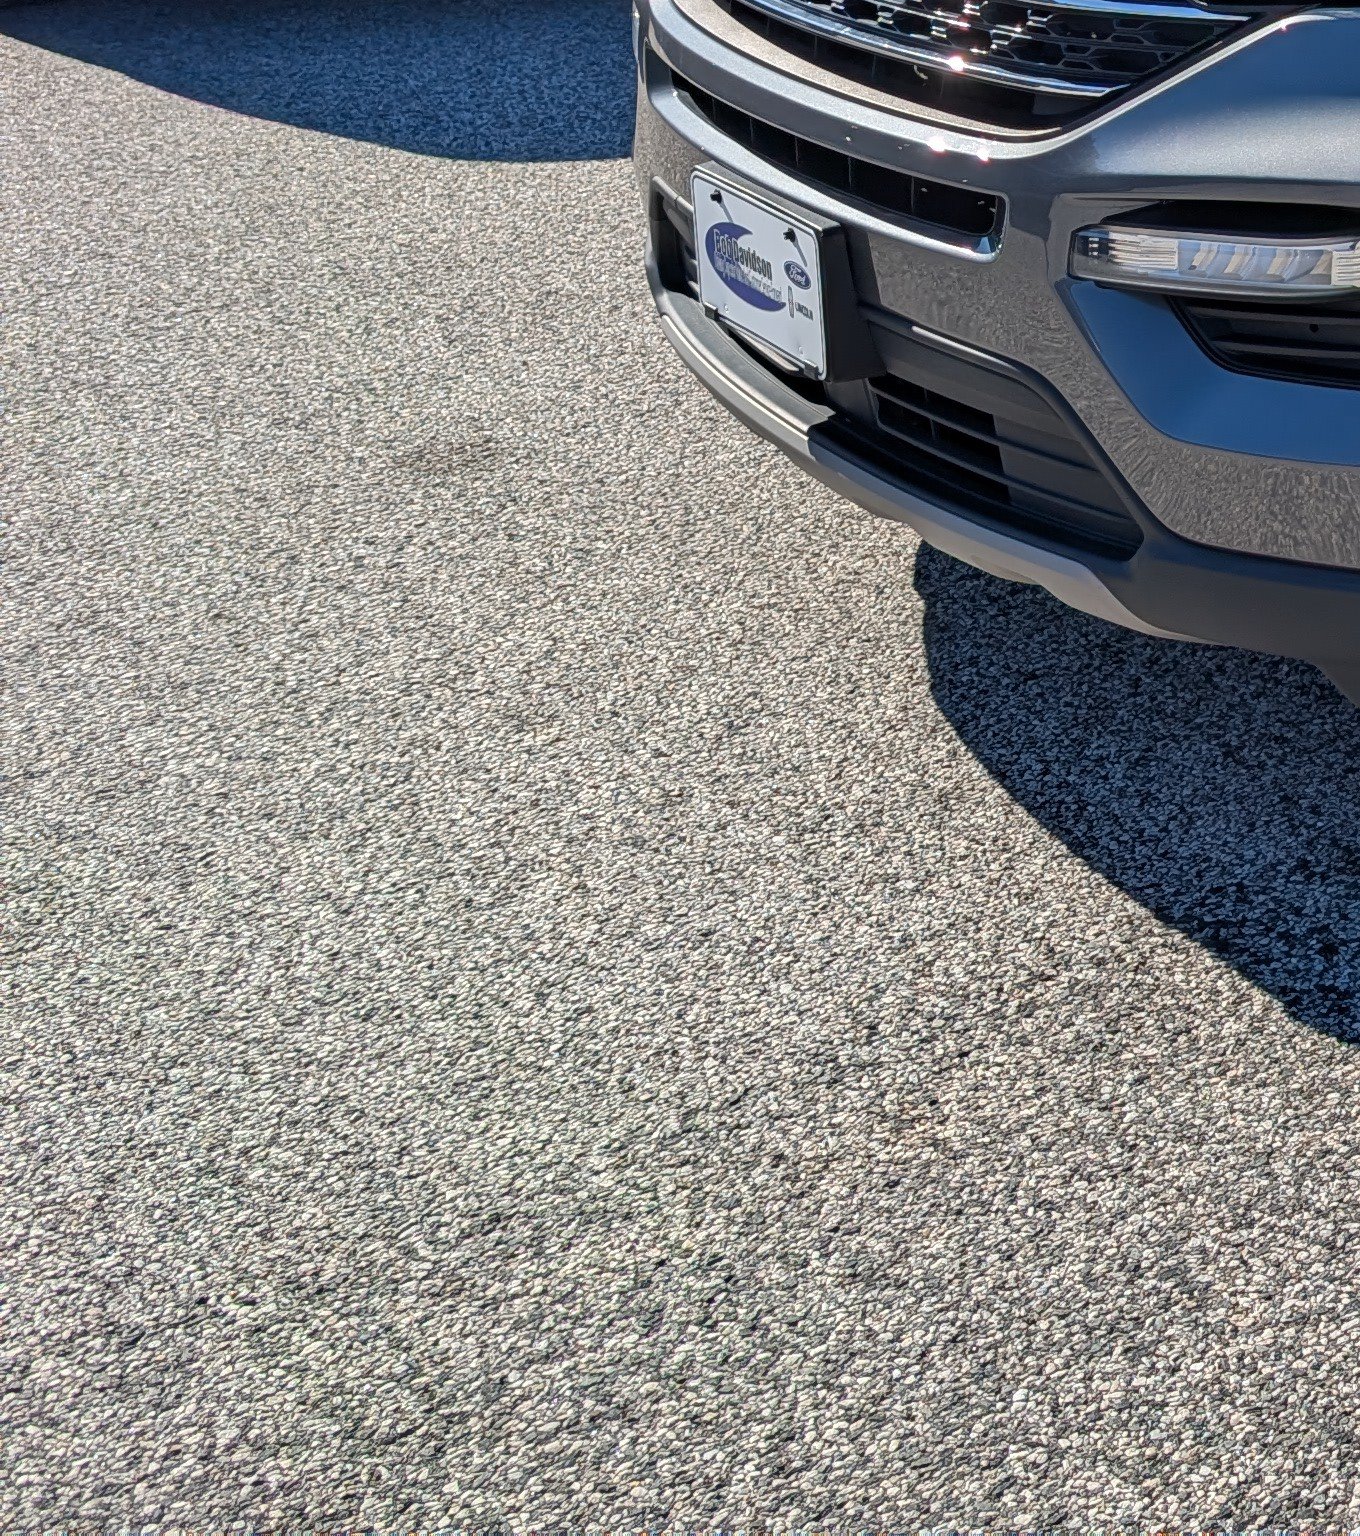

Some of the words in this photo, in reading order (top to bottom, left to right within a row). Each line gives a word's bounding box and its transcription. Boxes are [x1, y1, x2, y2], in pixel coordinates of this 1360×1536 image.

[713, 228, 732, 260] Bob
[731, 237, 773, 282] Davidson
[788, 264, 806, 286] Ford
